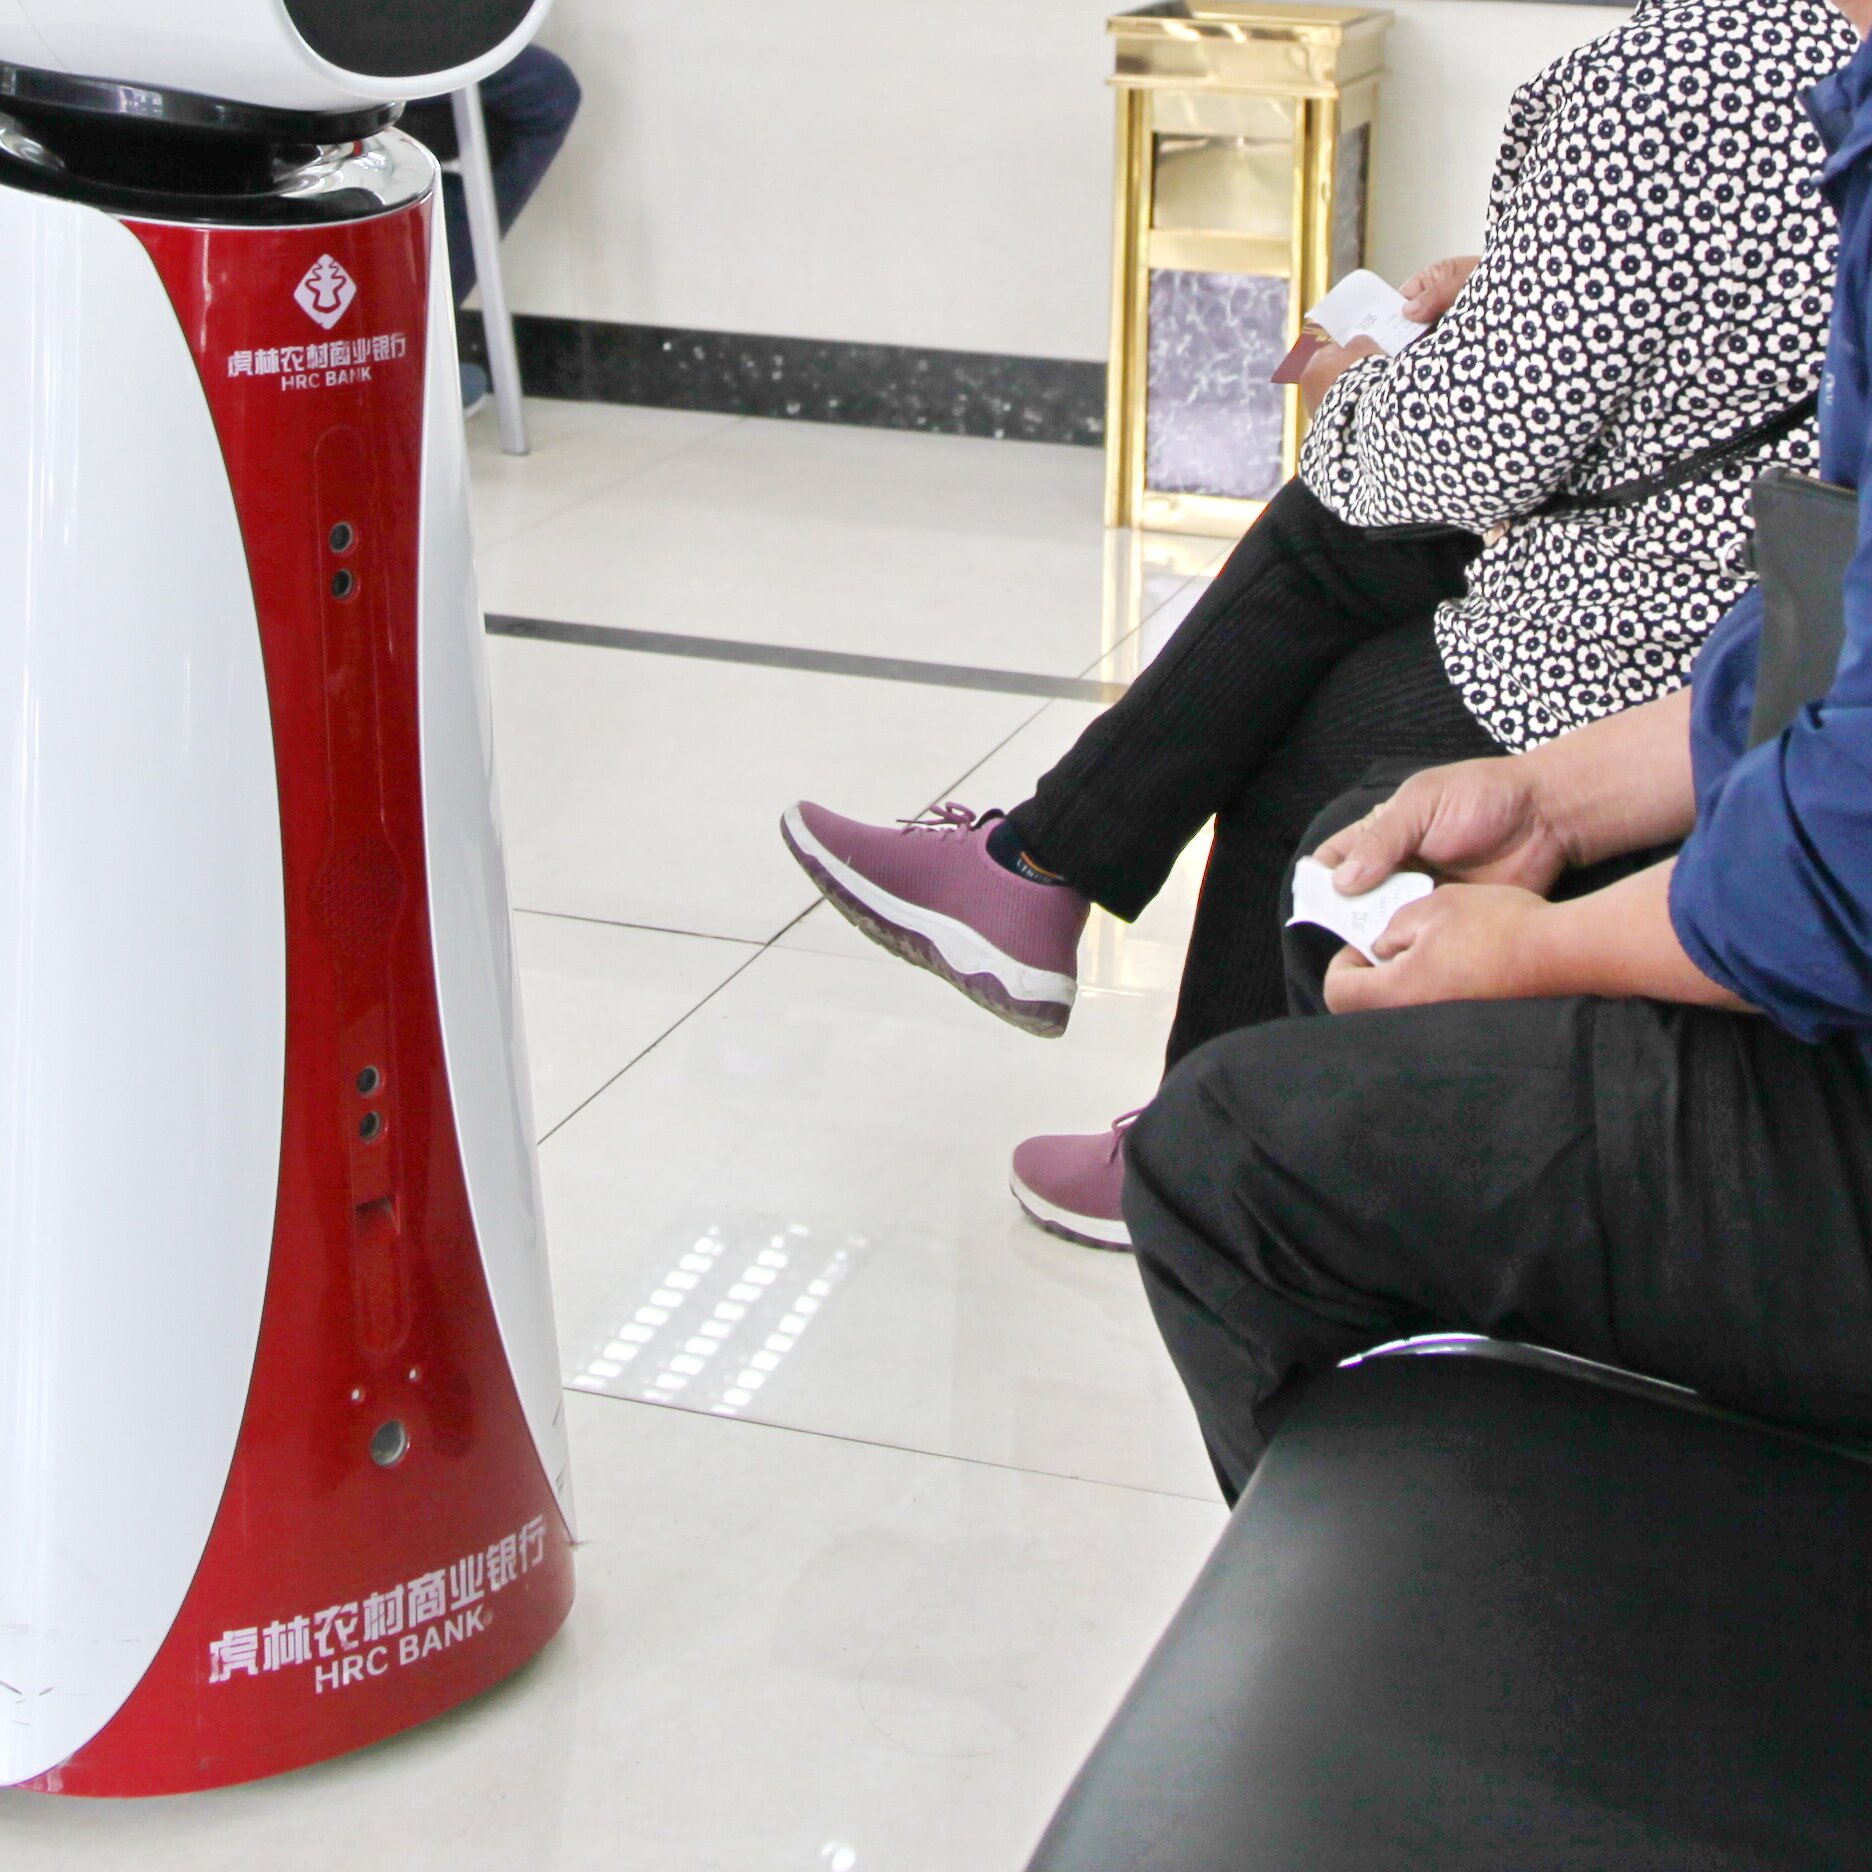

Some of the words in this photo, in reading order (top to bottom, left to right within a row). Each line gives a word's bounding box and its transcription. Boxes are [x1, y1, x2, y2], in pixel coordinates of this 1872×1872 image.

[228, 333, 406, 378] 虎林农村商业银行
[281, 372, 321, 391] HRC
[325, 366, 373, 387] BANK
[209, 1515, 547, 1685] 虎林农村商业银行
[315, 1647, 390, 1694] HRC
[398, 1610, 486, 1666] BANK
